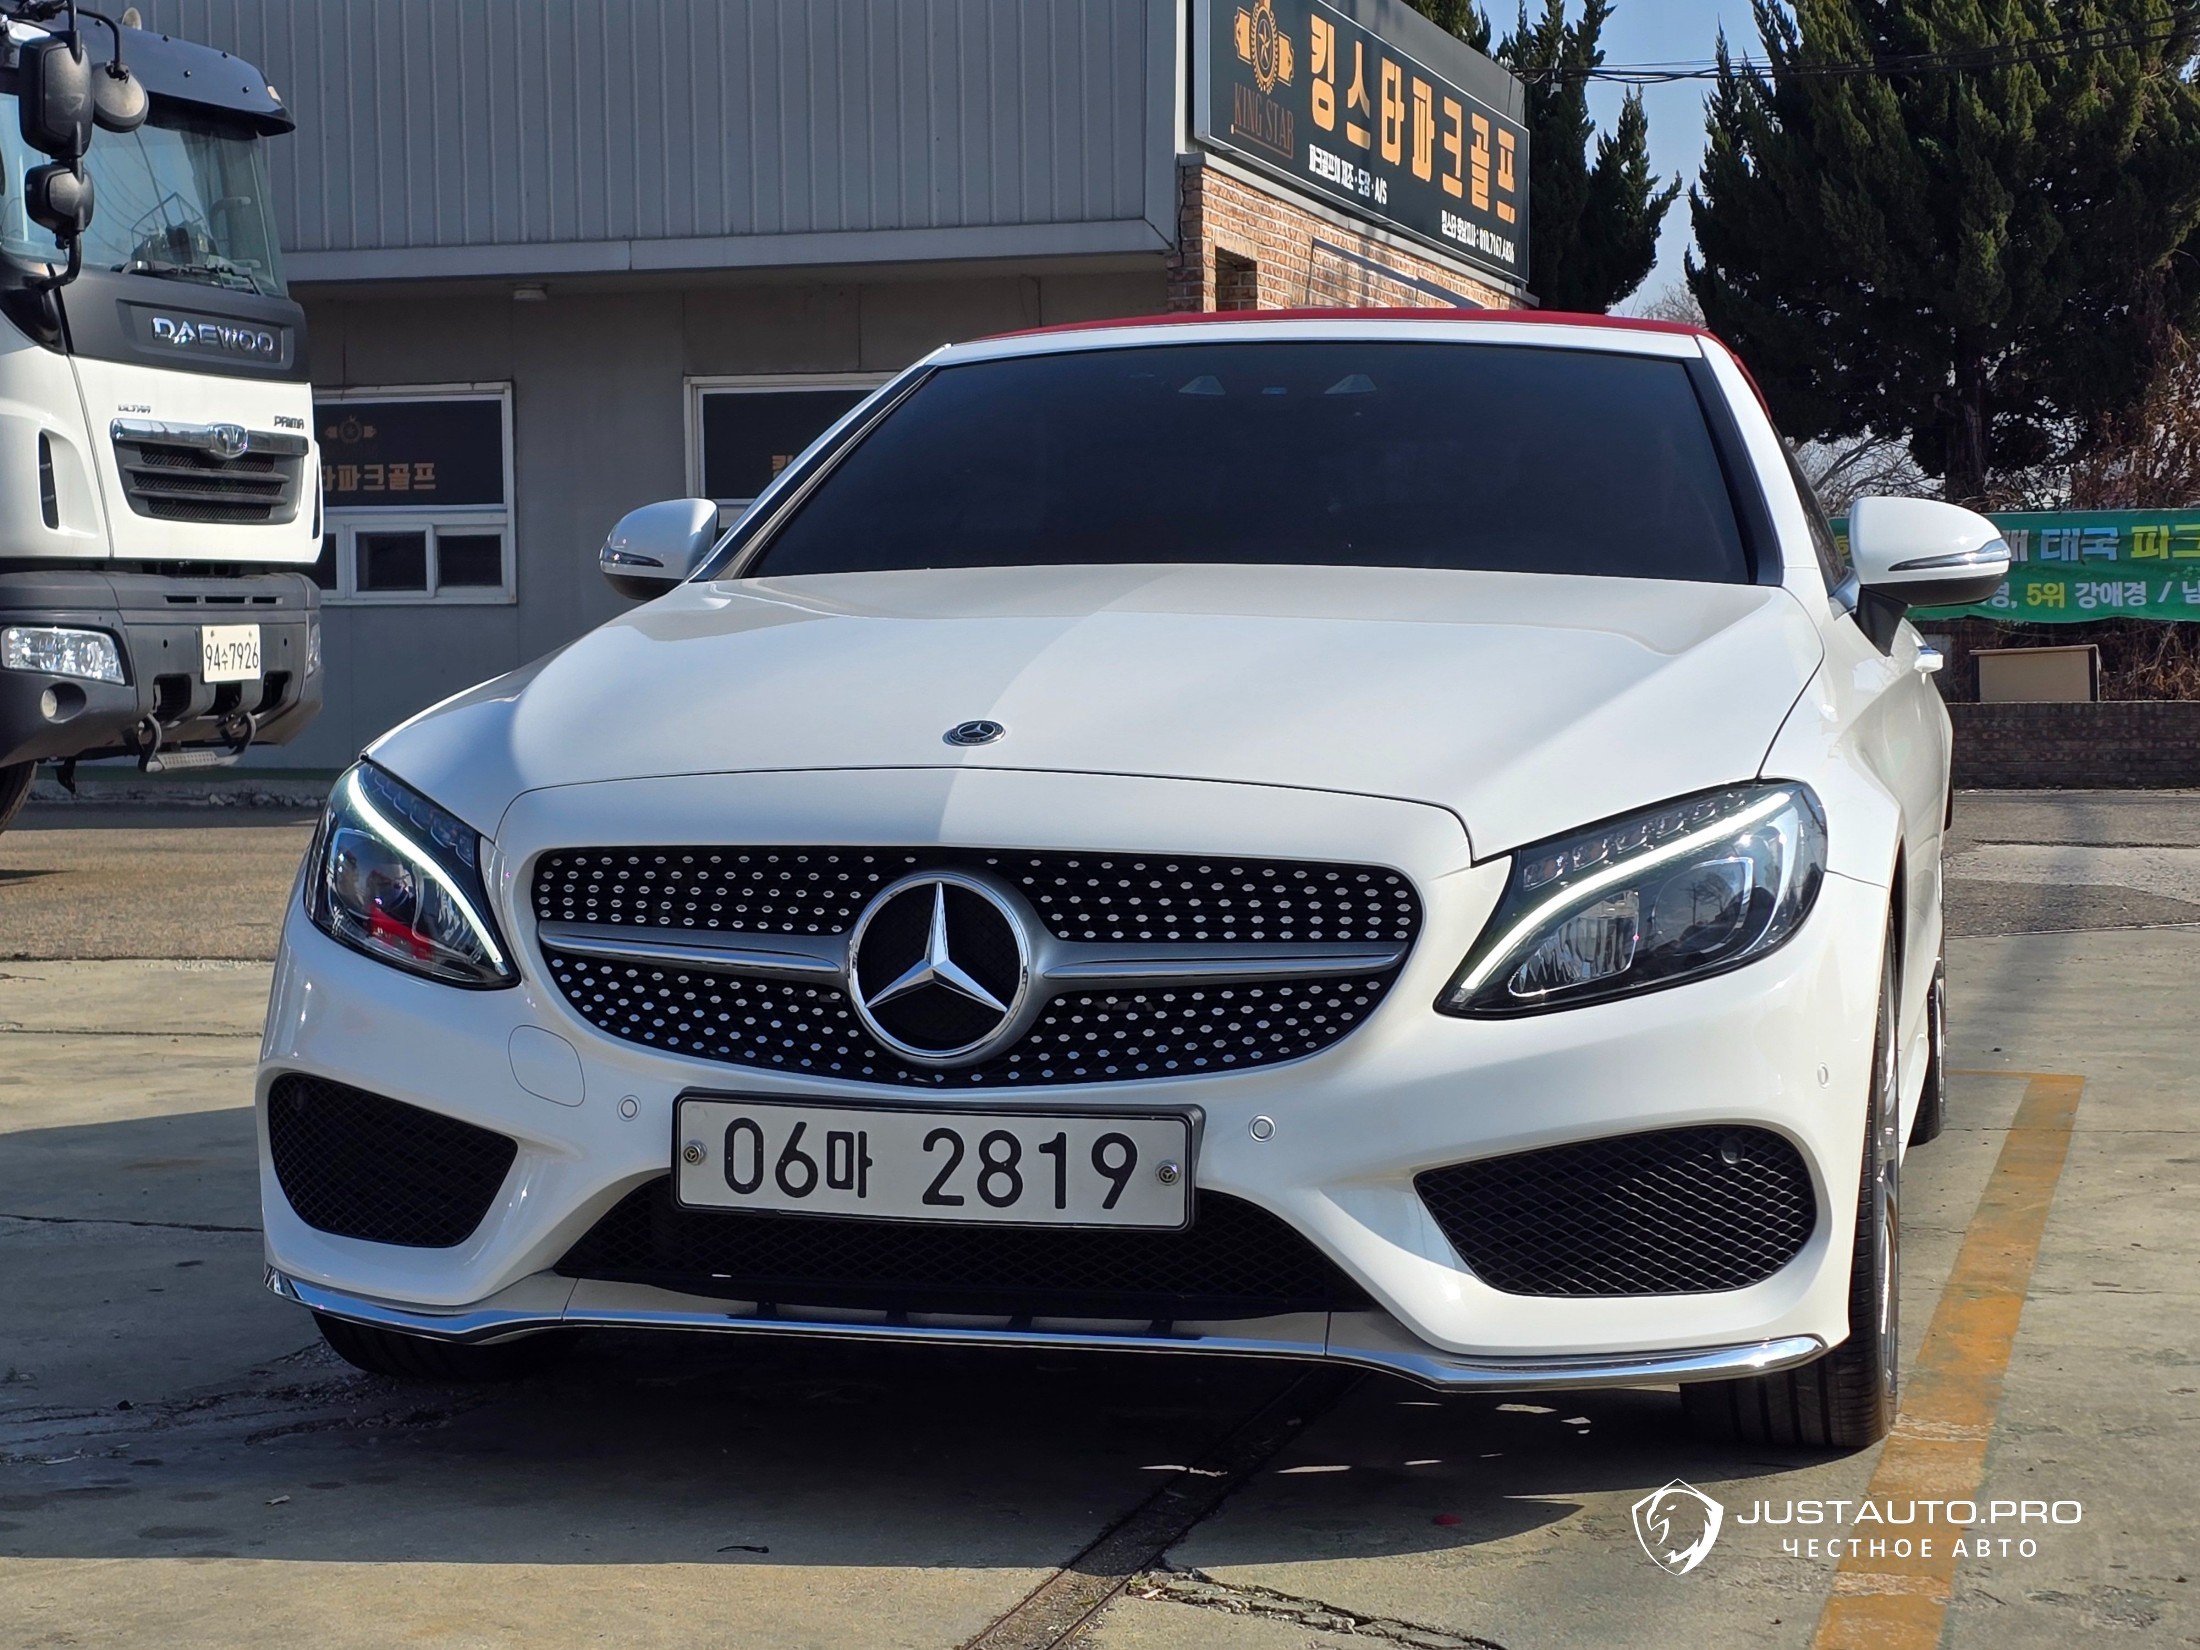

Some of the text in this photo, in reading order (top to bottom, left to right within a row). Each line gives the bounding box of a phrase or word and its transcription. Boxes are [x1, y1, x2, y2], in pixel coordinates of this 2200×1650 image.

[1234, 82, 1294, 159] KING STAR
[1310, 13, 1516, 225] 킹스타파크골프
[153, 317, 274, 354] DAEWOO
[274, 415, 305, 430] PRIMA
[2026, 582, 2065, 608] 5위
[2074, 581, 2147, 608] 강애경
[205, 641, 259, 671] 94수7926
[724, 1117, 1138, 1210] 06마 2819
